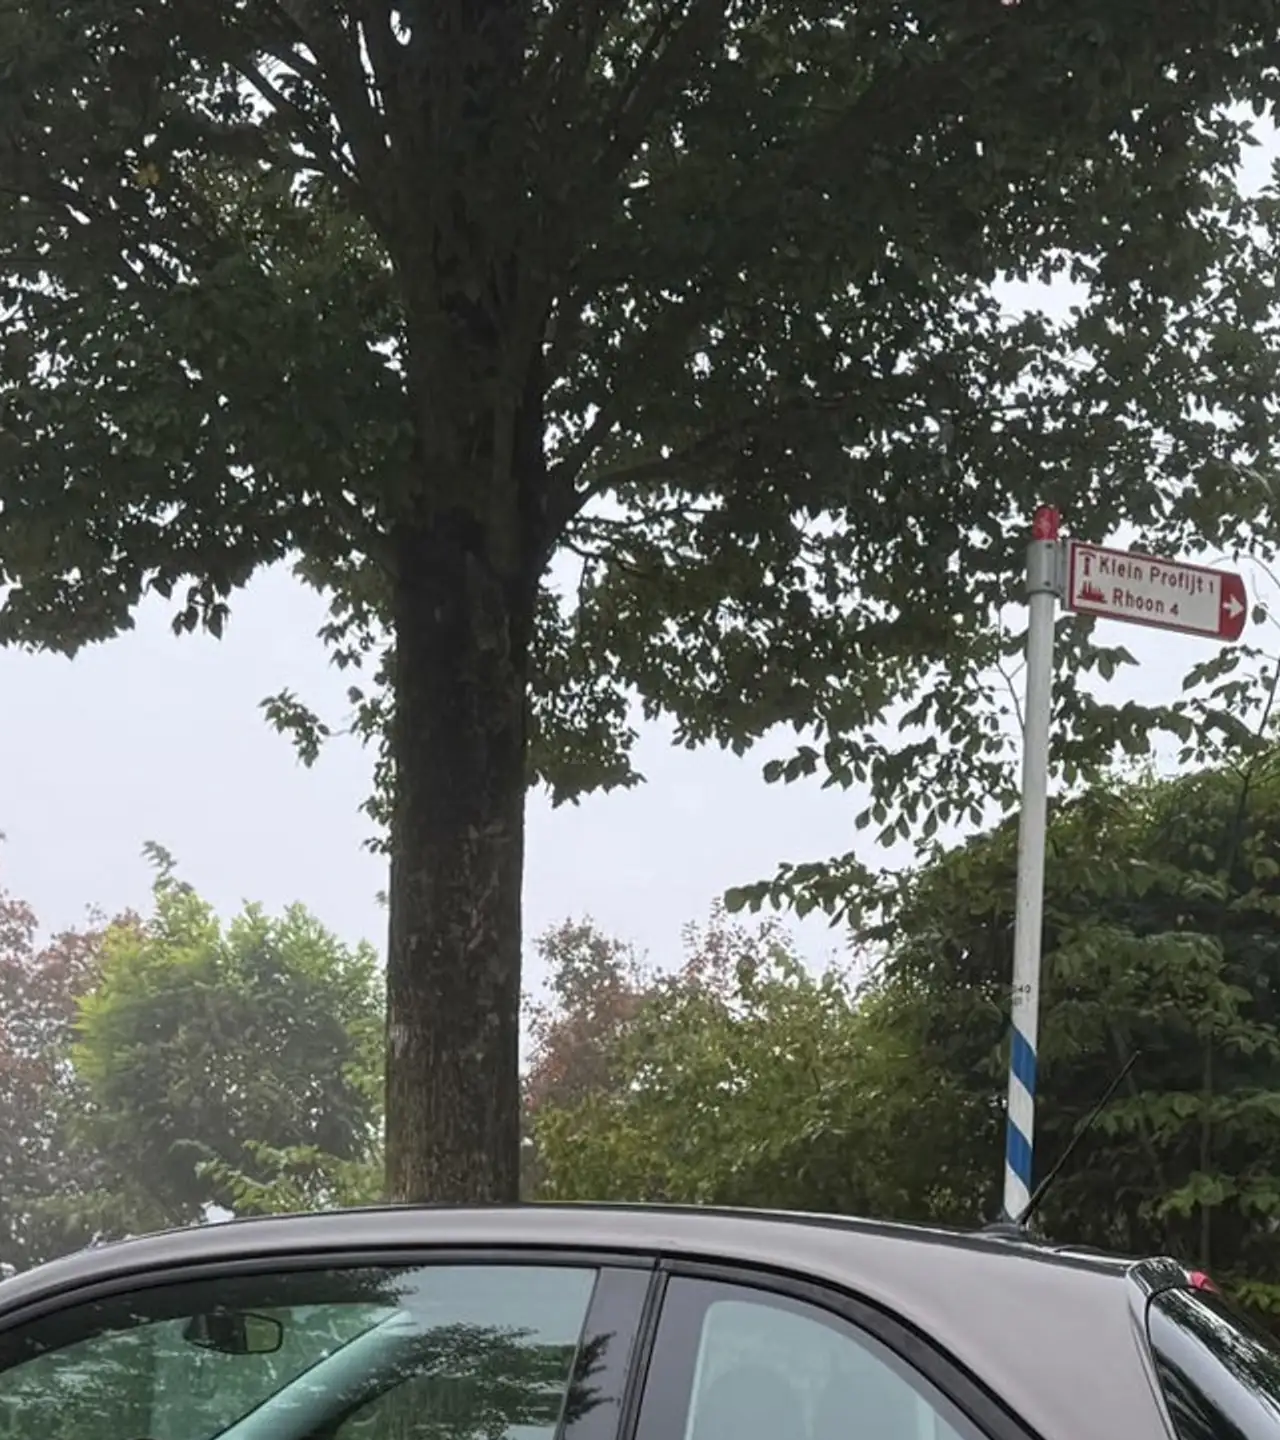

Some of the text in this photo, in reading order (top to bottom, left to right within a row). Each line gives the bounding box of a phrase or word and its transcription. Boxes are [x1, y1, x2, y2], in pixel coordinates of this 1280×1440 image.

[1099, 556, 1214, 596] Klein Profijt 1
[1112, 588, 1179, 616] Rhoon 4
